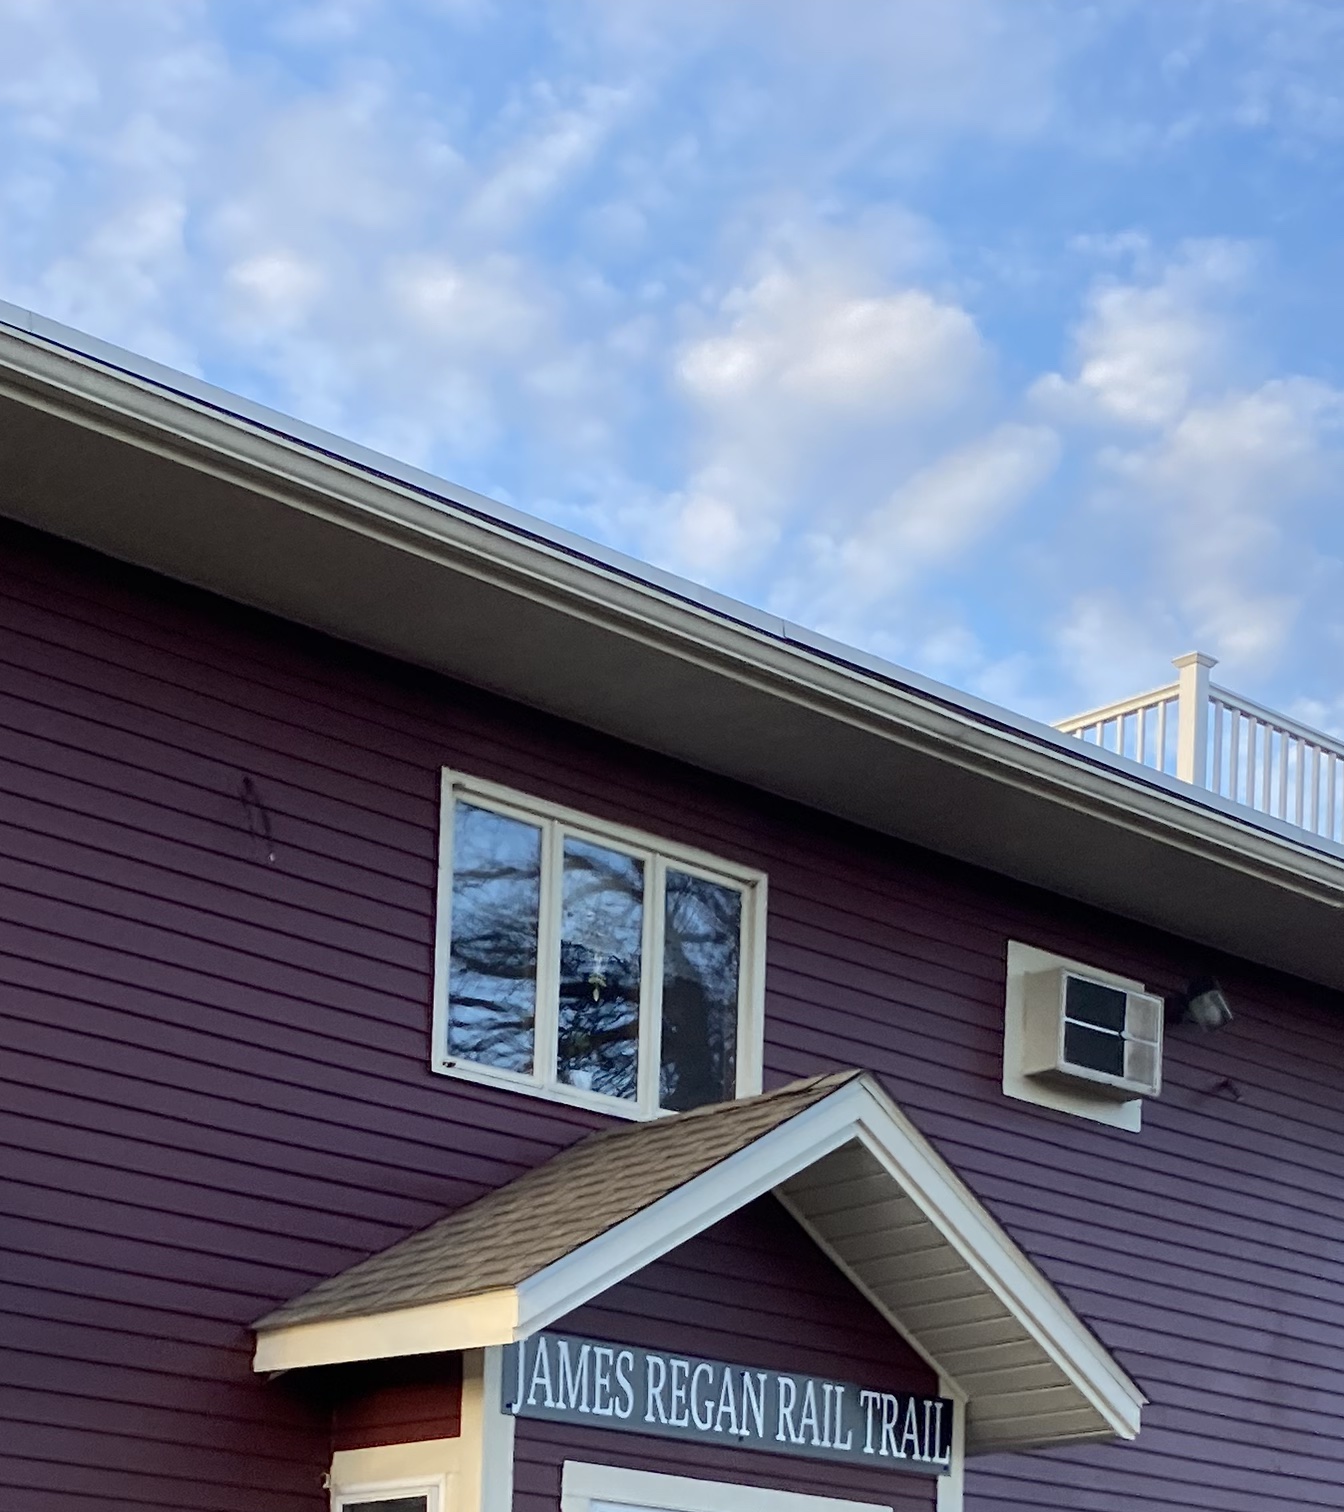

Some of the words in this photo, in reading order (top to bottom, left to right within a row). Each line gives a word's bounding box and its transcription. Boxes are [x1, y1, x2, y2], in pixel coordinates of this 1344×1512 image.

[511, 1336, 635, 1419] JAMES
[644, 1354, 767, 1439] REGAN
[776, 1376, 852, 1451] RAIL
[860, 1389, 951, 1465] TRAIL
